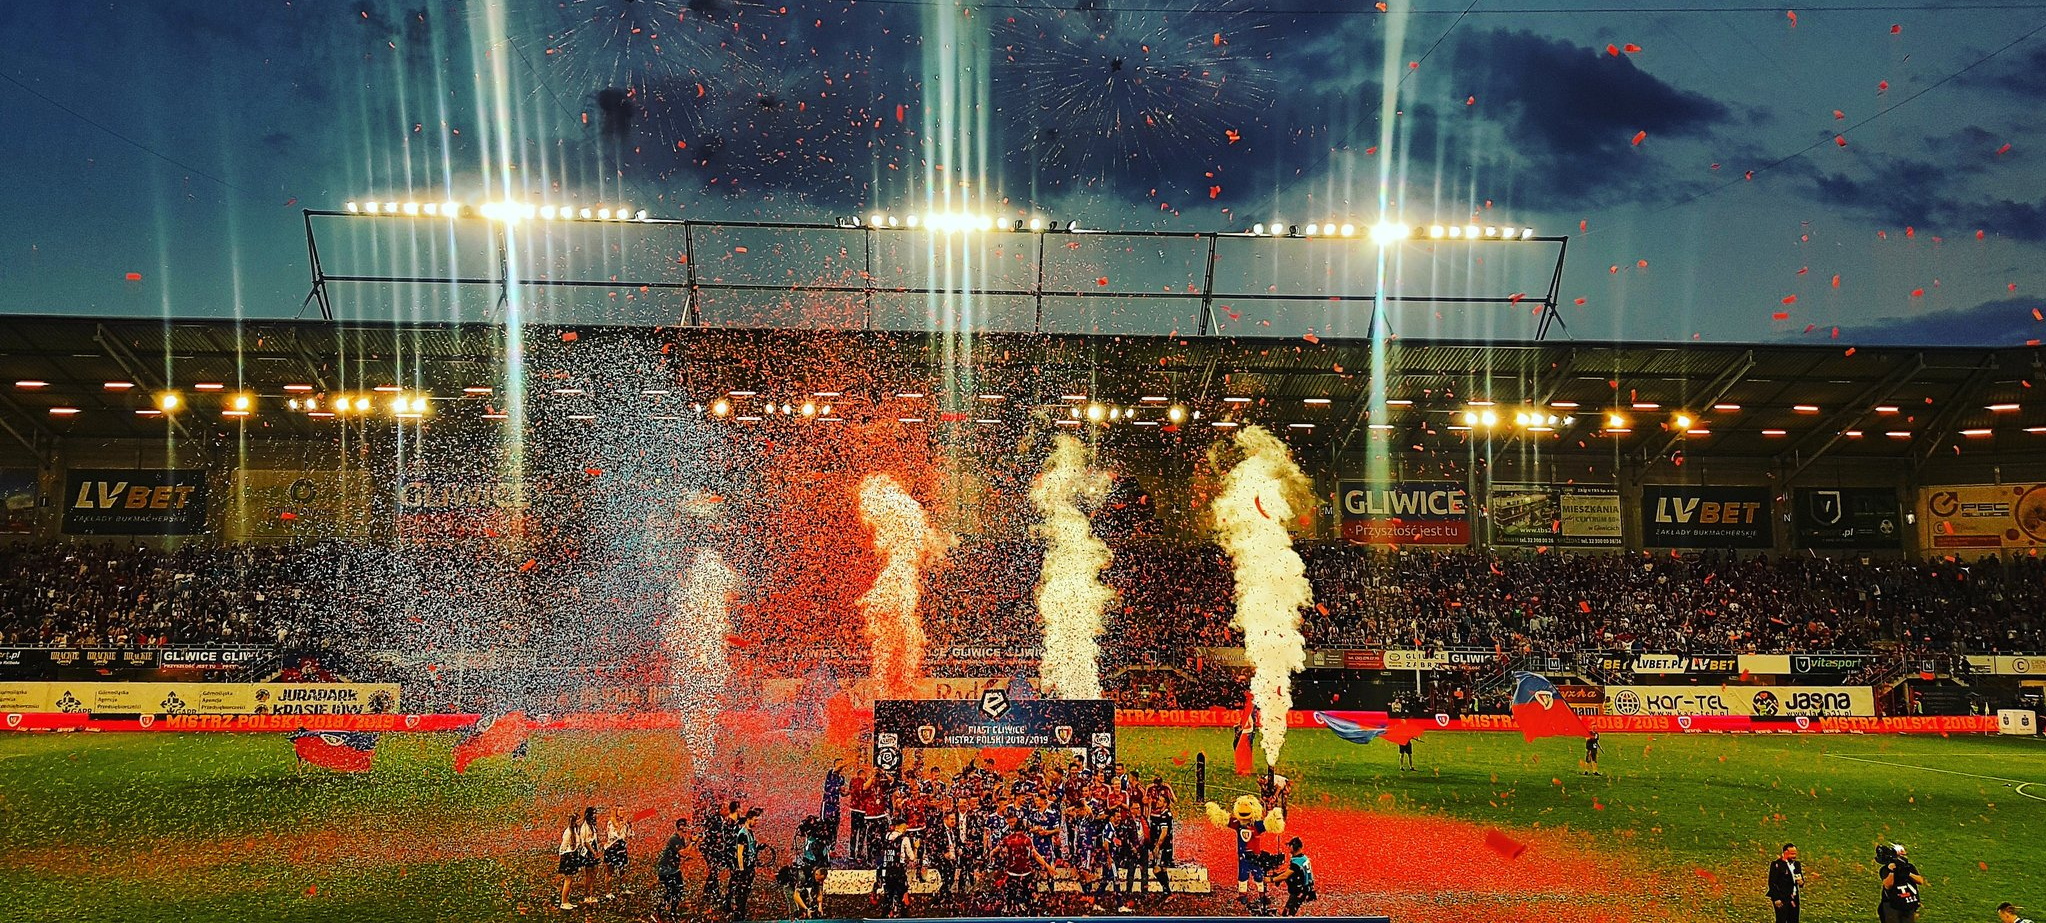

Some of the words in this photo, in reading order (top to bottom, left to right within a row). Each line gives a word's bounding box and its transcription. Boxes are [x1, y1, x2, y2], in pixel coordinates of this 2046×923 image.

[1344, 489, 1466, 515] GLIWICE
[1961, 503, 2009, 511] PEC
[1325, 506, 1333, 515] M
[1563, 505, 1620, 514] MIESZKANIA
[1783, 513, 1791, 522] N
[1355, 524, 1415, 537] Przyszłość
[1418, 527, 1442, 540] jest
[1445, 525, 1458, 536] tu
[1637, 659, 1684, 669] LVBET.PL
[1811, 657, 1863, 670] vitasport
[166, 714, 233, 729] MISTRZ
[305, 715, 396, 730] 2018/2019
[1160, 709, 1217, 724] POLSKI
[1589, 716, 1670, 730] 2018/2019
[1819, 716, 1880, 730] MISTRZ
[1883, 716, 1939, 731] POLSKI
[945, 735, 974, 744] MISTRZ
[976, 735, 1004, 744] POLSKI
[1006, 735, 1049, 745] 2018/2019
